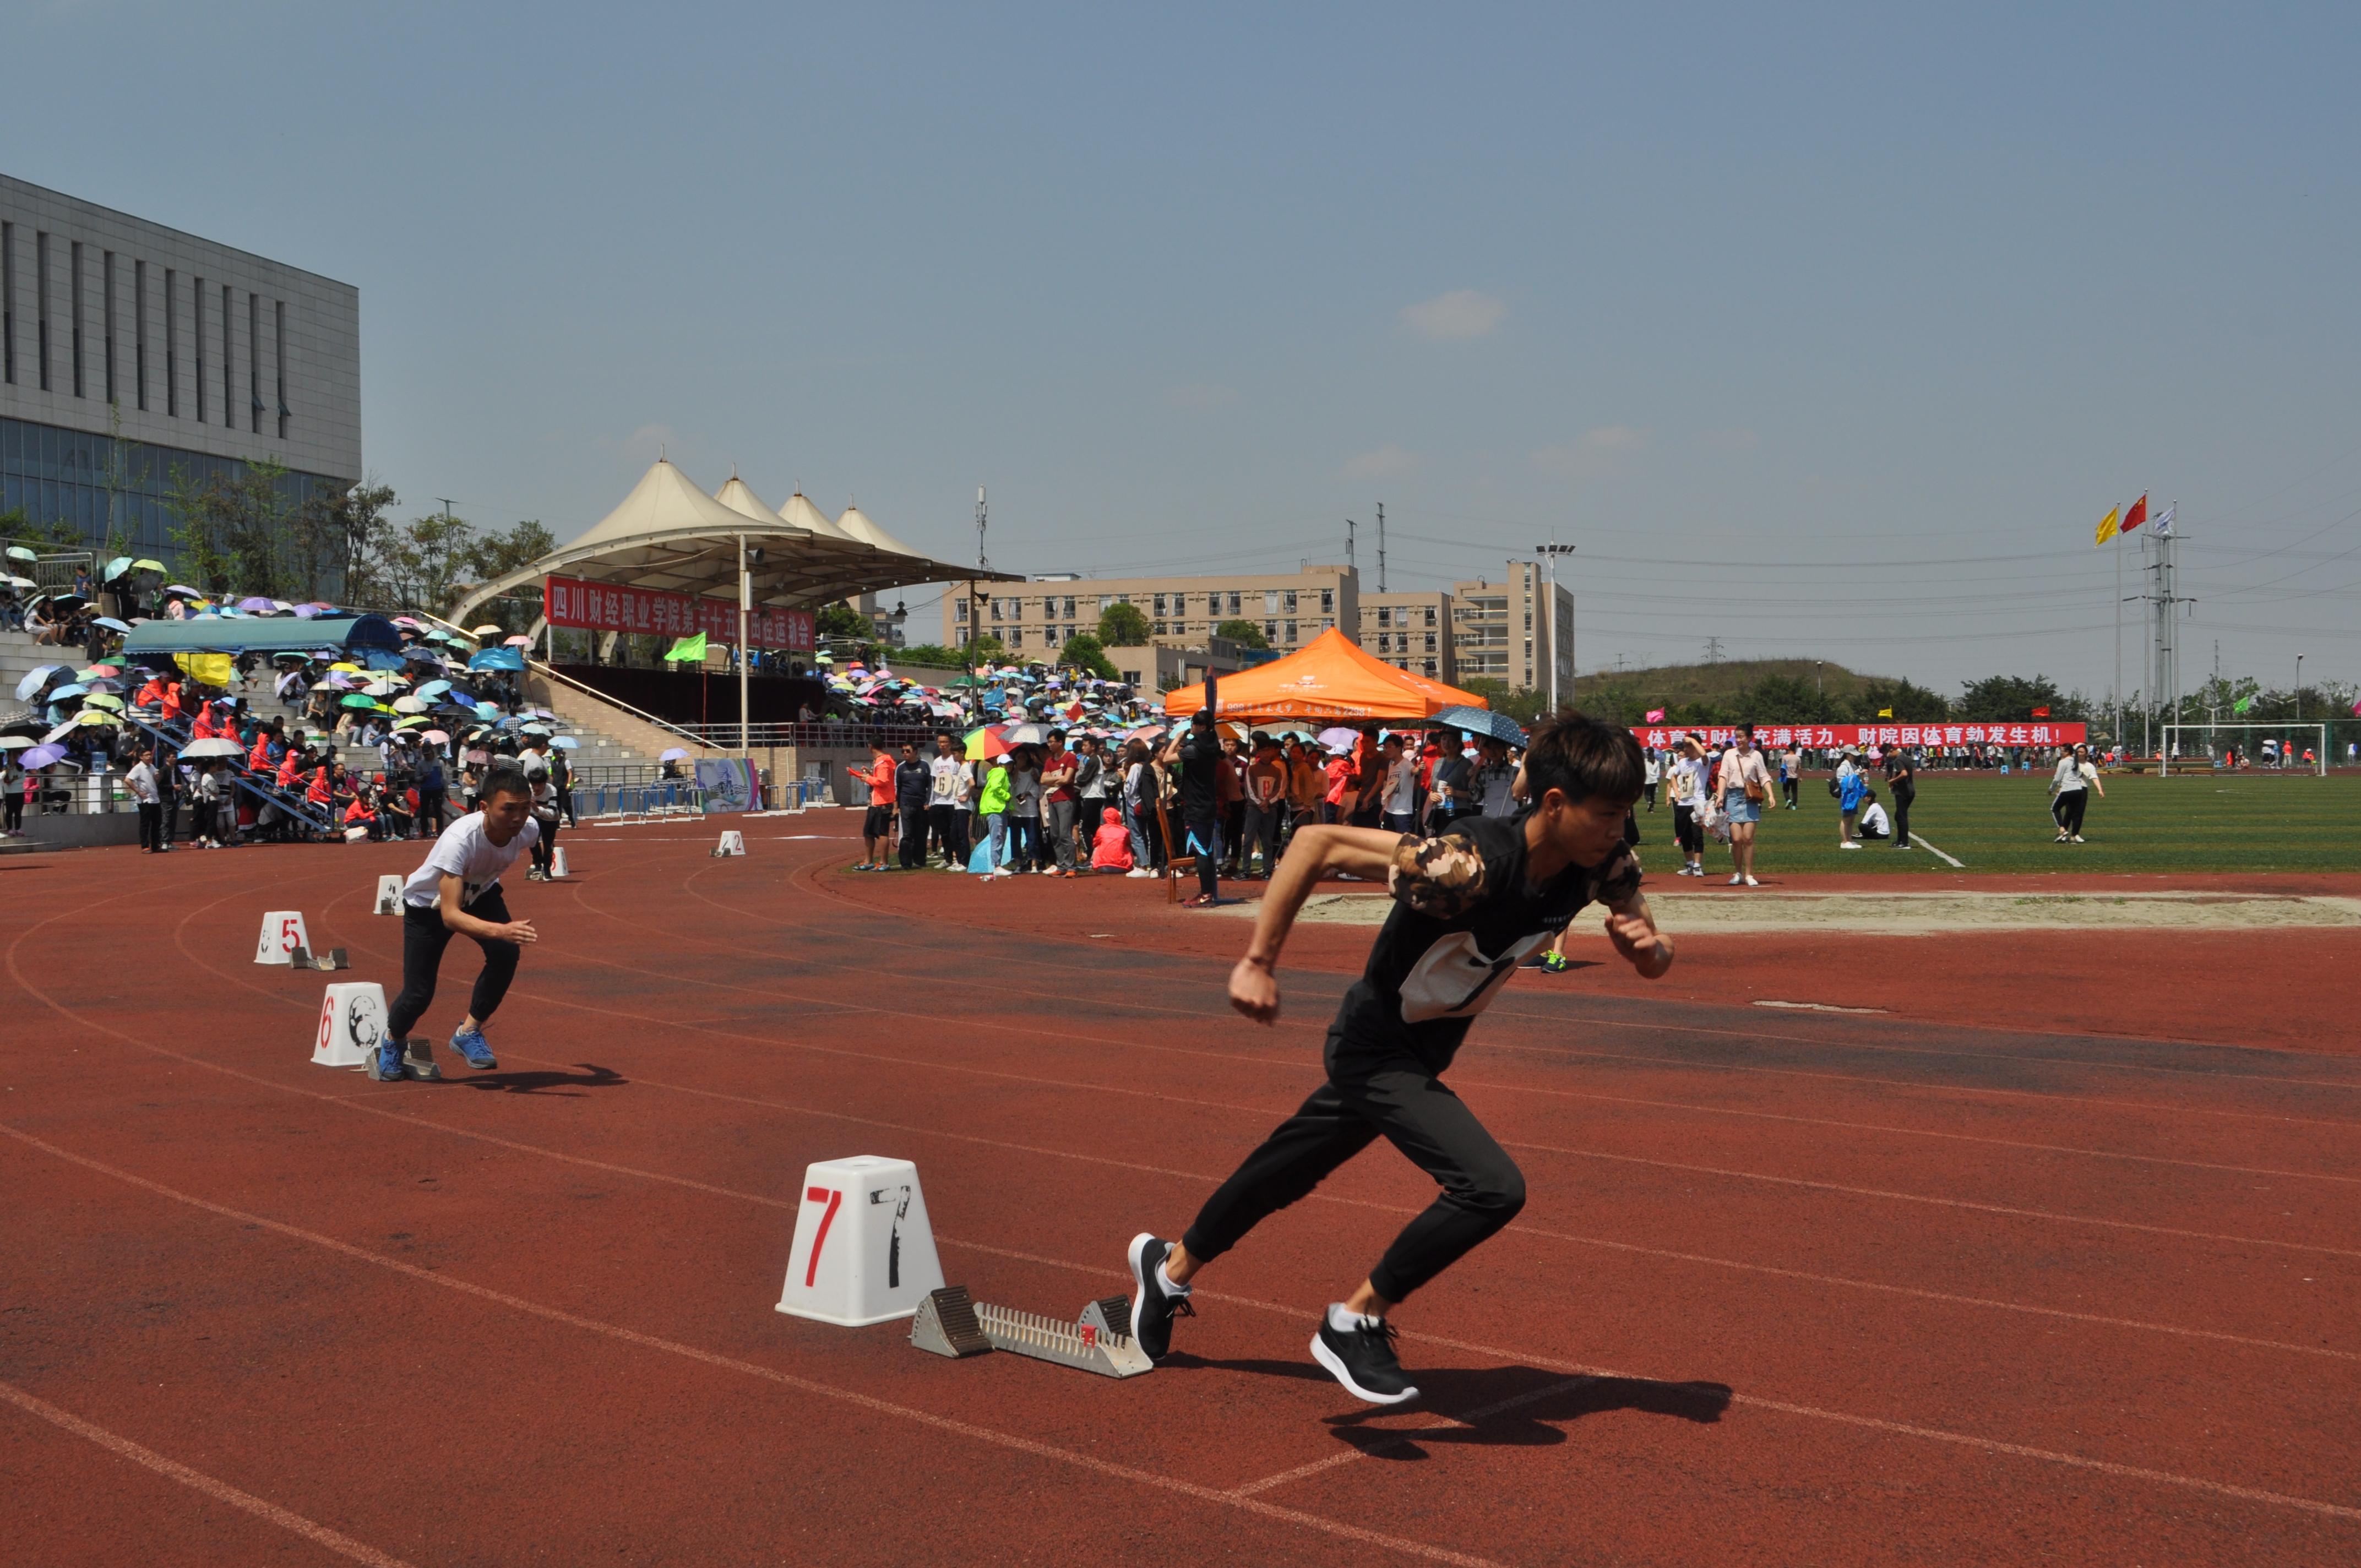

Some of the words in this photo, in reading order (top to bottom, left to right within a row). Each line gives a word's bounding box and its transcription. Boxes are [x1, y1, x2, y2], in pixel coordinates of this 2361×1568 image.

[553, 586, 808, 646] 四川财经职业学院第三十五田径运动会
[1647, 726, 2060, 747] 体育使财充满活力，财院因体育勃发生机！
[939, 777, 945, 792] 6
[1682, 776, 1689, 792] 5
[734, 834, 741, 851] 2
[282, 919, 300, 954] 5
[320, 995, 335, 1049] 6
[349, 995, 379, 1049] 6
[805, 1186, 842, 1287] 7
[869, 1185, 911, 1288] 7
